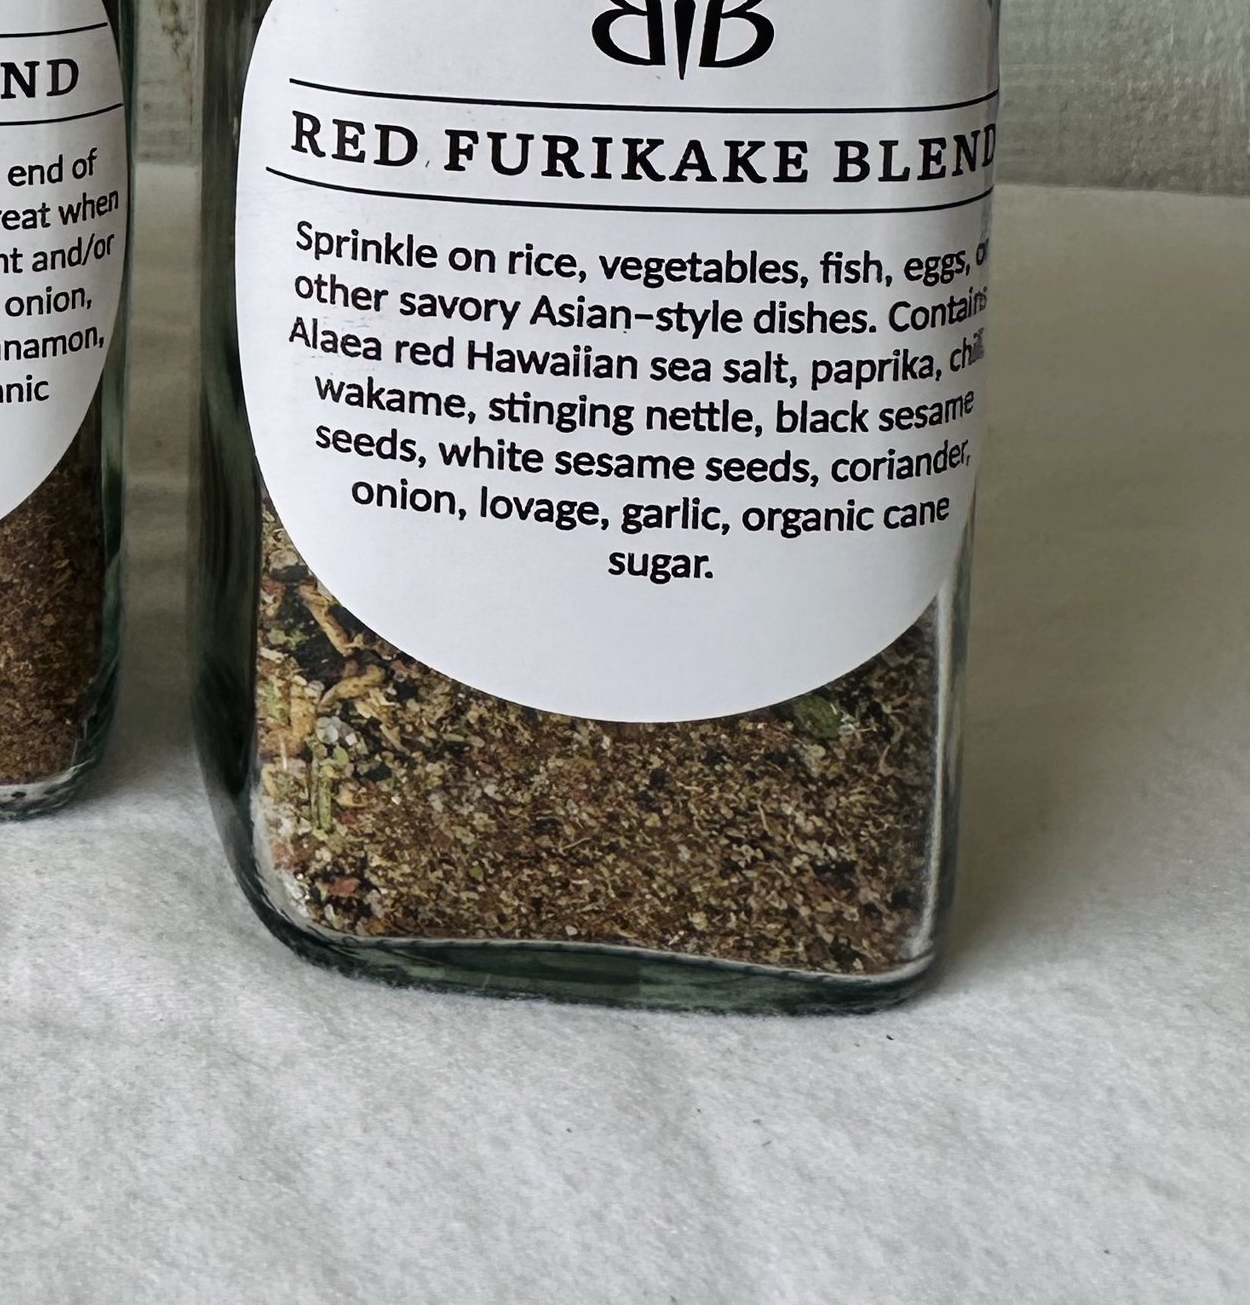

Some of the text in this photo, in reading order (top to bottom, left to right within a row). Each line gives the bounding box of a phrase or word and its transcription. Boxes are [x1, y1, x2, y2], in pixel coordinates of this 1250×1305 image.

[7, 153, 64, 188] end
[71, 146, 98, 180] of
[290, 109, 997, 185] RED FURIKAKE BLEND
[57, 189, 119, 226] when
[31, 232, 115, 273] and/or
[295, 220, 439, 269] Sprinkle
[447, 246, 497, 274] on
[507, 242, 588, 284] rice,
[598, 248, 809, 290] vegetables,
[819, 249, 893, 288] fish,
[903, 249, 971, 288] eggs,
[4, 285, 93, 318] onion,
[293, 273, 390, 313] other
[398, 291, 522, 332] savory
[753, 300, 877, 335] dishes.
[288, 315, 383, 362] Alaea
[394, 335, 455, 369] red
[466, 339, 639, 380] Hawaiian
[649, 356, 712, 383] sea
[722, 350, 798, 390] salt,
[810, 348, 943, 392] paprika,
[314, 375, 975, 438] wakame, stinging nettle, black sesame
[315, 424, 971, 488] seeds, white sesame seeds, coriander,
[351, 477, 950, 540] onion, lovage, garlic, organic cane
[607, 551, 714, 585] sugar.
